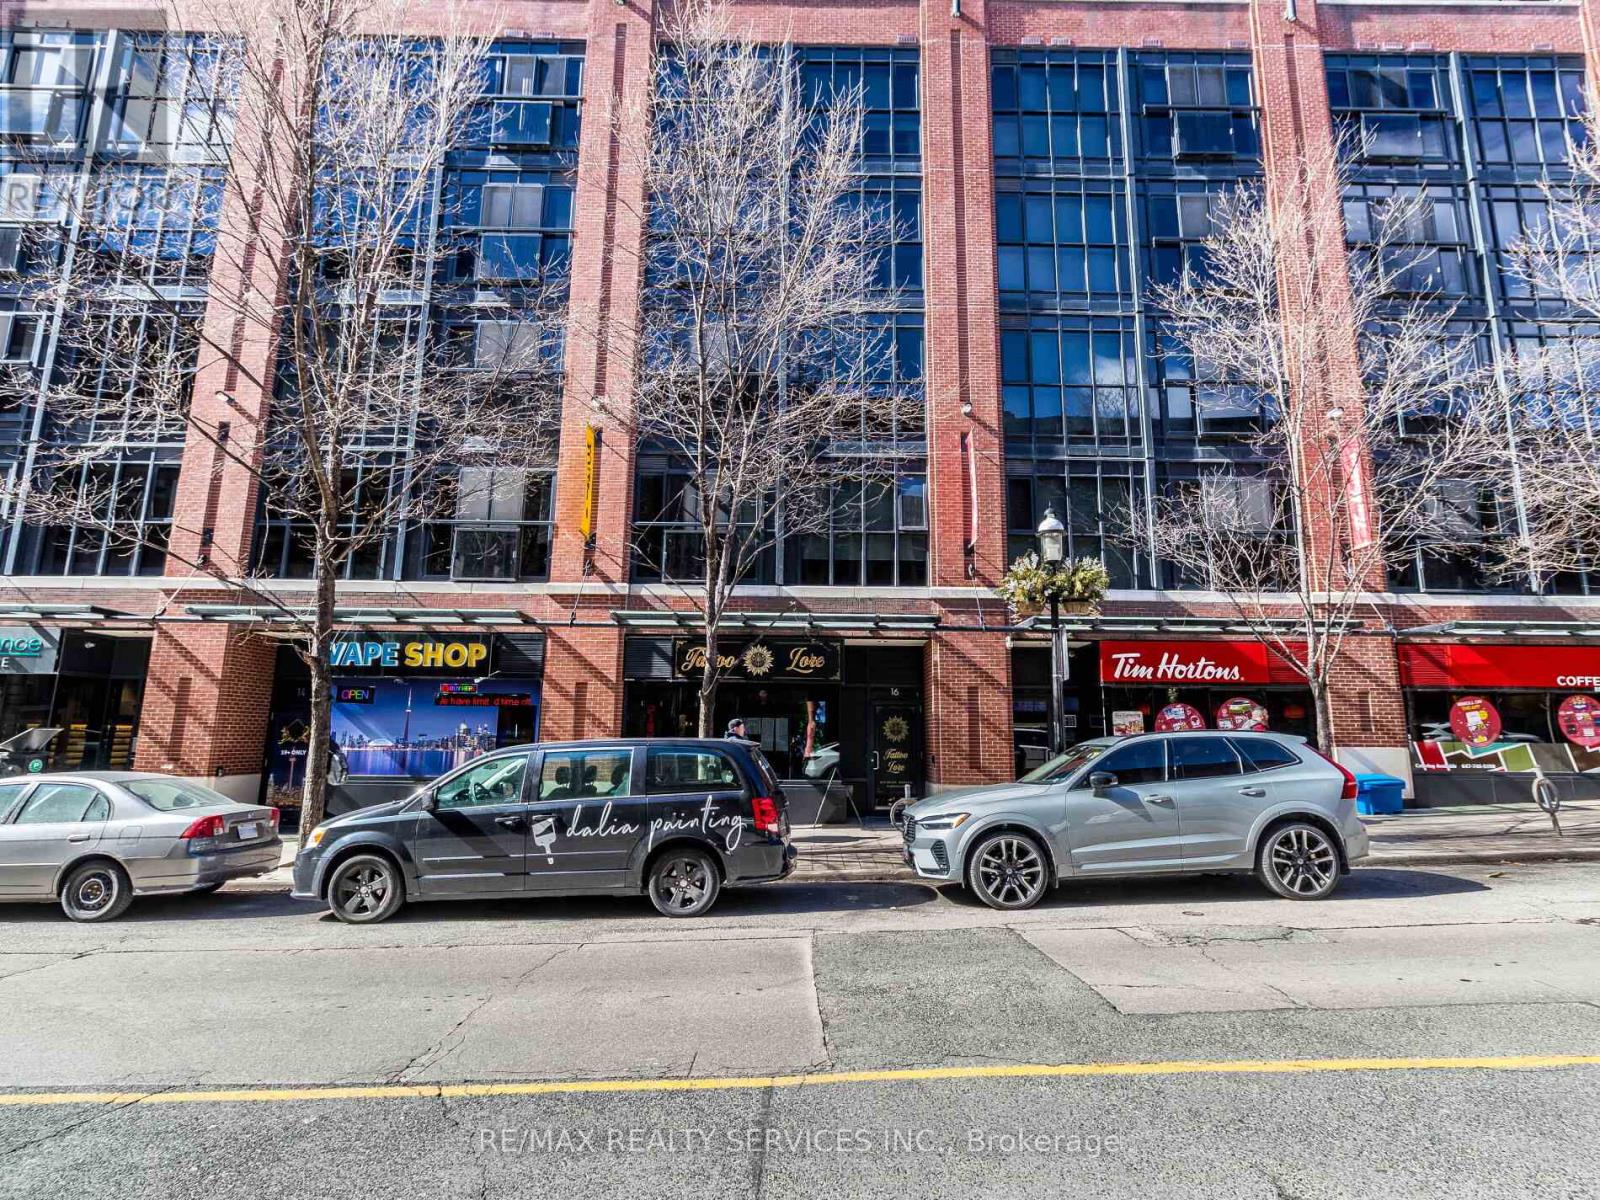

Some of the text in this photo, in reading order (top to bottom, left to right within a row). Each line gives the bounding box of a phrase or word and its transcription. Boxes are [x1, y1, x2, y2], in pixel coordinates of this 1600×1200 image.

[330, 642, 487, 667] VAPE SHOP
[681, 646, 735, 672] Taoo
[1112, 653, 1154, 679] Tim
[341, 690, 369, 700] OPEN
[891, 688, 900, 696] 16
[566, 794, 747, 853] dalia painting
